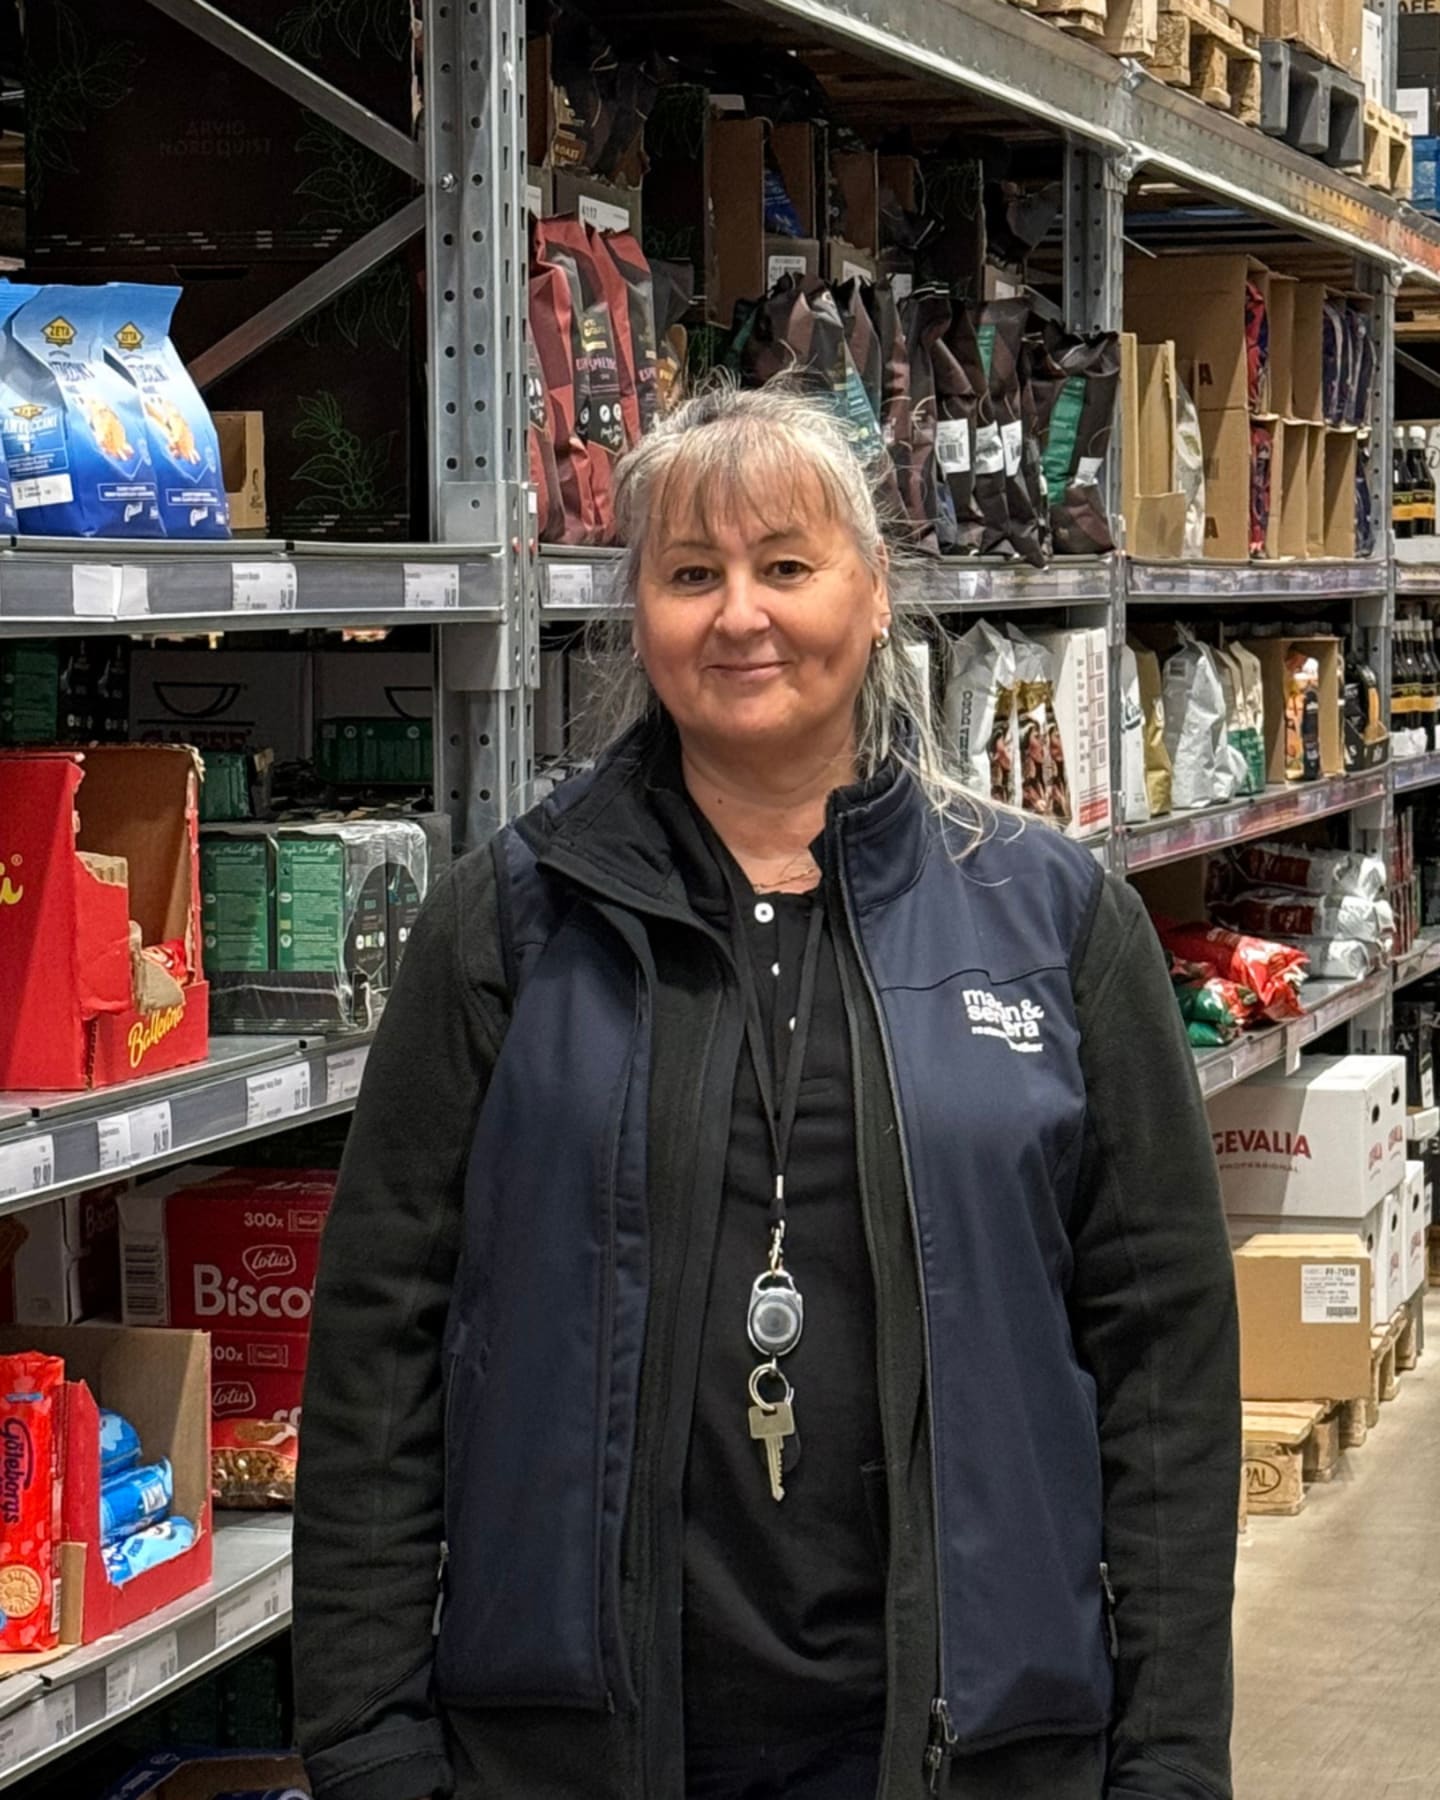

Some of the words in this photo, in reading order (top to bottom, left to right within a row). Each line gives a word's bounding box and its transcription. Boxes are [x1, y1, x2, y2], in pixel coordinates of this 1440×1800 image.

[1212, 1129, 1312, 1160] GEVALIA
[243, 1211, 285, 1229] 300x
[251, 1249, 291, 1271] Lotus
[193, 1263, 316, 1320] Bisco
[213, 1345, 244, 1362] 00x
[213, 1386, 250, 1407] Lotus
[0, 1417, 36, 1526] Göteborgs
